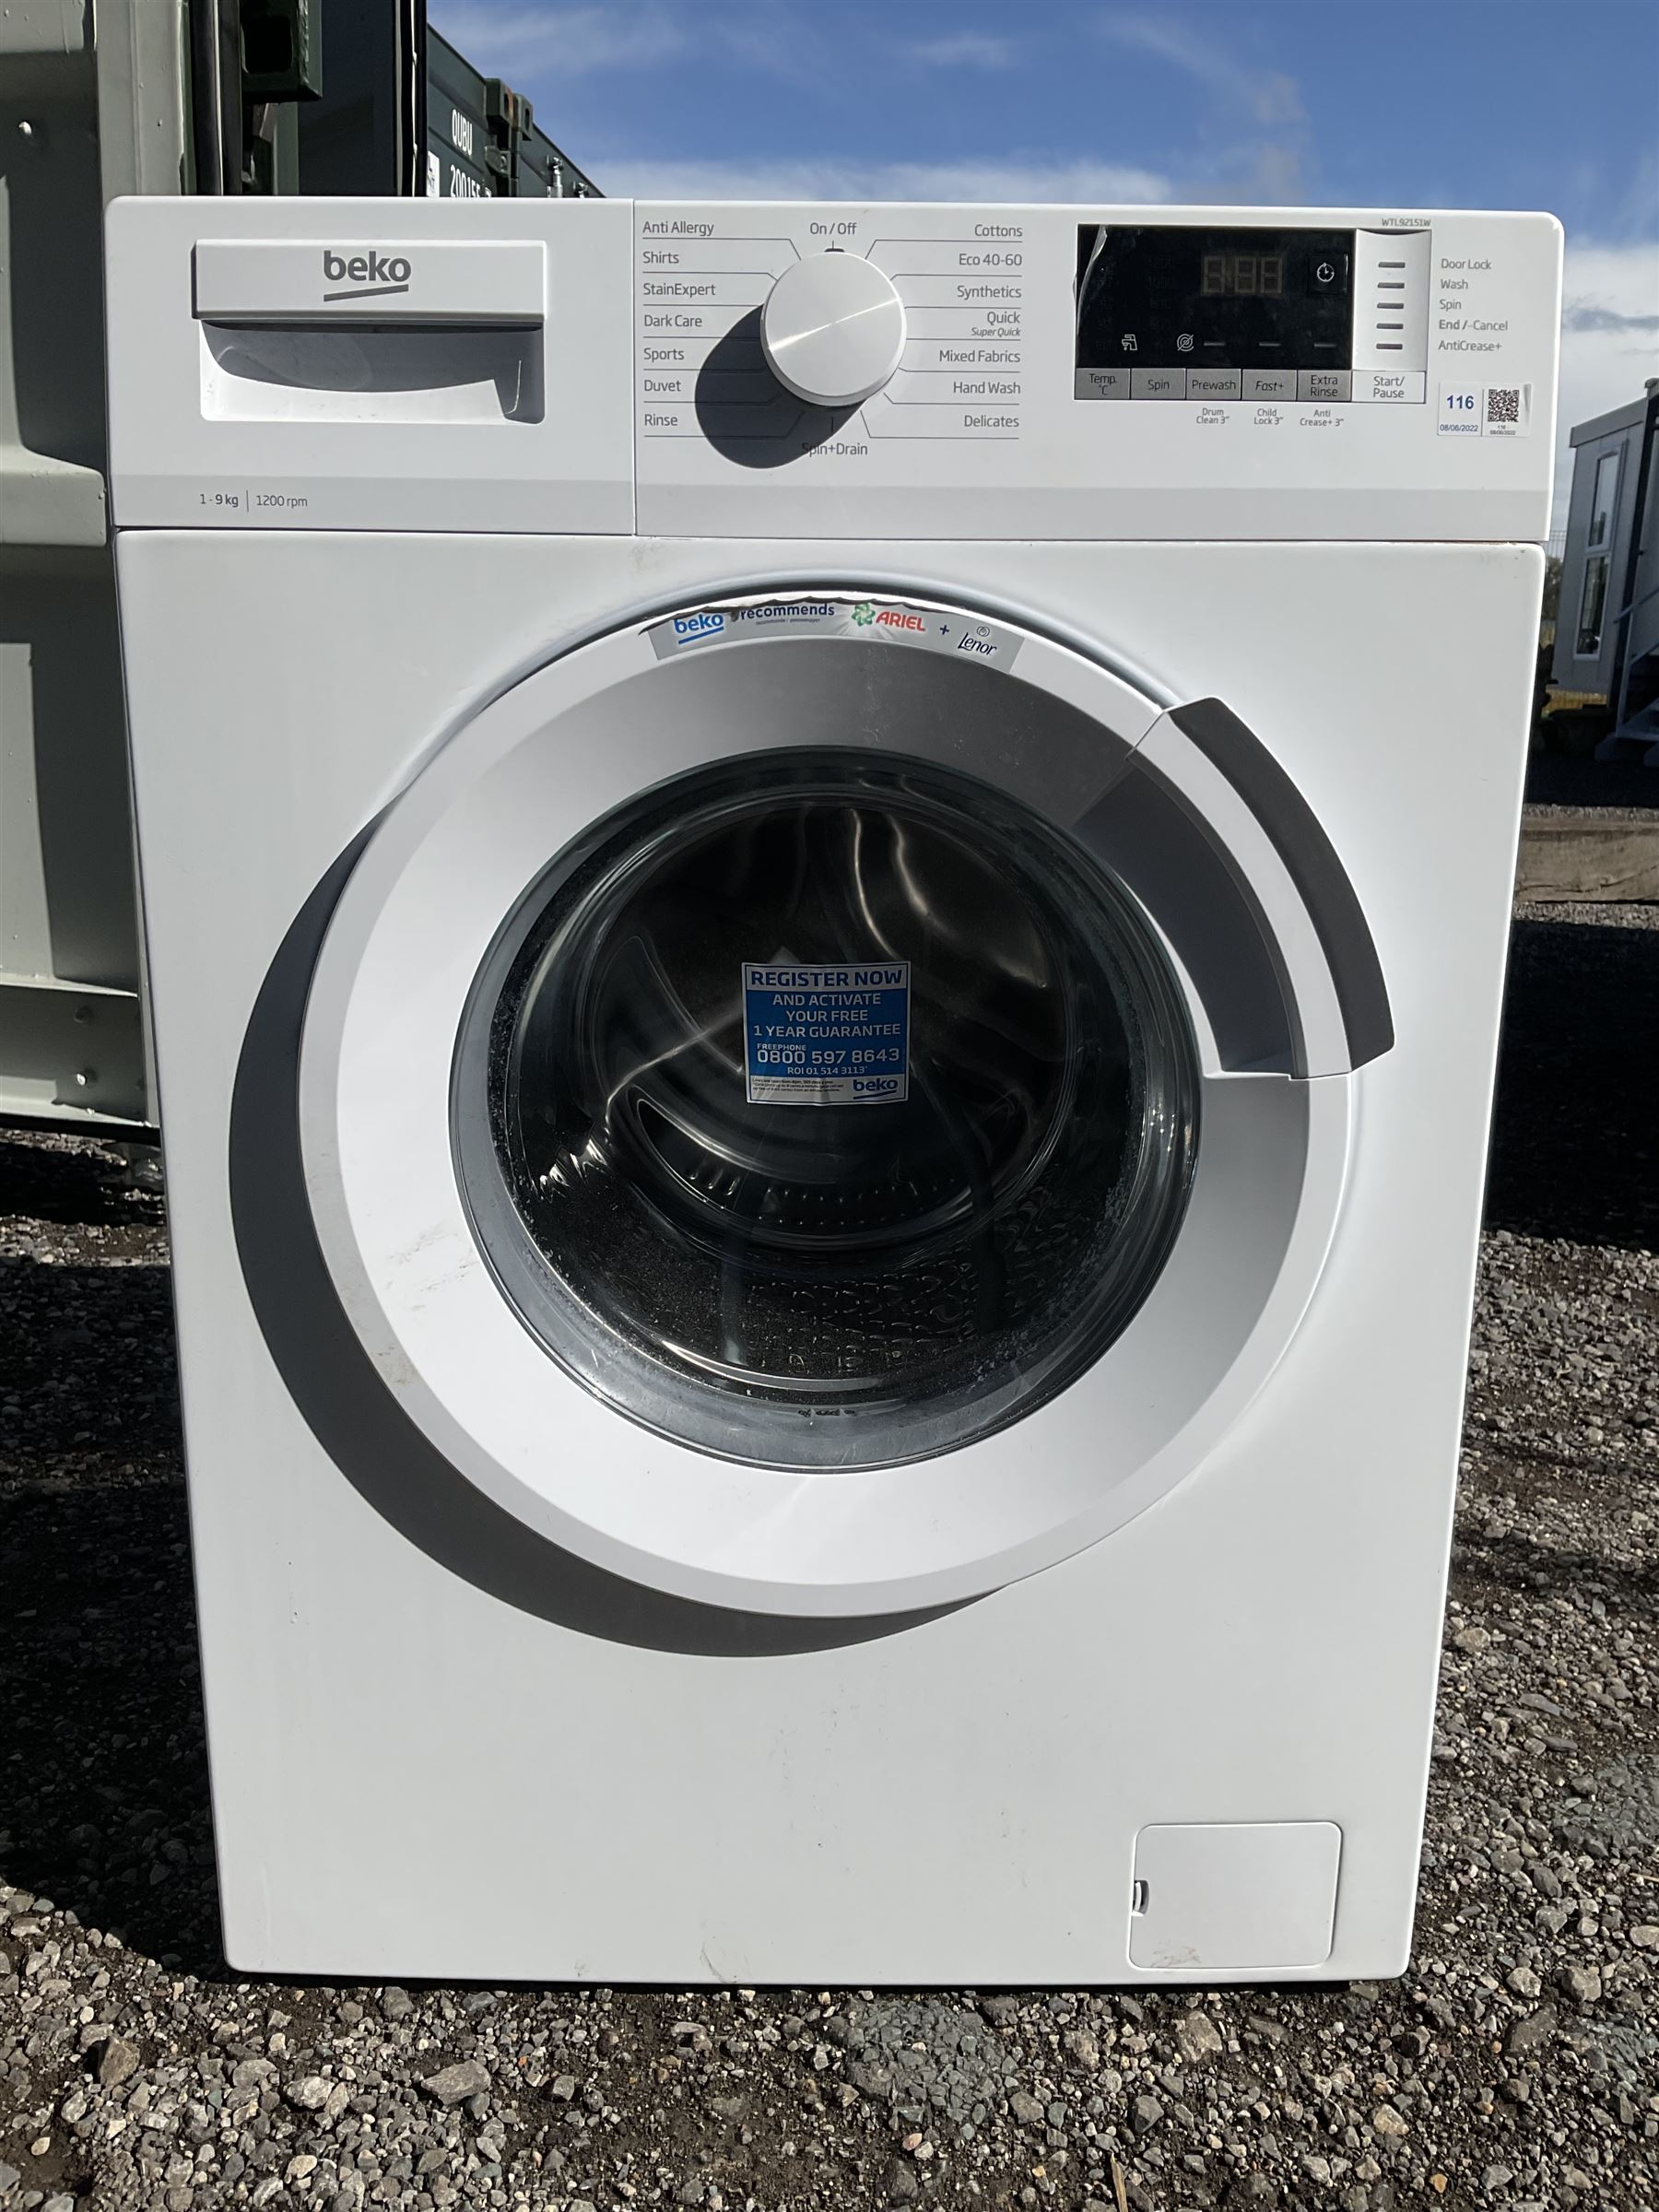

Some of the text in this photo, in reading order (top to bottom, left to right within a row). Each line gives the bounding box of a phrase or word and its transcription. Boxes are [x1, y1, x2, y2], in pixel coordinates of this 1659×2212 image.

[452, 109, 473, 155] QUBU
[642, 221, 714, 237] Anti Allergy
[810, 222, 827, 235] On
[837, 222, 857, 235] Off
[1382, 218, 1431, 227] WTL92151W
[974, 224, 1023, 237] Cottons
[642, 251, 679, 264] Shirts
[959, 253, 1022, 266] Eco 40-60
[1441, 258, 1491, 270] Door Lock
[324, 250, 411, 282] beko
[1441, 278, 1468, 289] Wash
[643, 283, 715, 298] StainExpert
[957, 286, 1022, 300] Synthetics
[1439, 299, 1462, 312] Spin
[644, 314, 702, 326] Dark Care
[986, 312, 1020, 325] Quick
[1439, 319, 1460, 330] End
[971, 326, 1021, 337] Super Quick
[1438, 340, 1502, 351] AntiCrease+
[643, 347, 685, 362] Sports
[939, 349, 1020, 362] Mixed Fabrics
[644, 379, 681, 392] Duvet
[1088, 373, 1116, 385] Temp.
[1147, 379, 1170, 392] Spin
[1192, 380, 1236, 390] Prewash
[1311, 374, 1338, 385] Extra
[1373, 376, 1405, 386] Start/
[953, 382, 1021, 394] Hand Wash
[1254, 381, 1284, 392] Fast+
[1310, 387, 1338, 397] Rinse
[1372, 388, 1405, 398] Pause
[1446, 394, 1475, 409] 116
[1202, 407, 1224, 416] Drum
[1257, 408, 1277, 417] Child
[1313, 409, 1331, 418] Anti
[644, 414, 678, 427] Rinse
[964, 415, 1020, 428] Delicates
[1196, 416, 1218, 424] Clean
[1253, 417, 1273, 425] Lock
[1300, 418, 1333, 427] Crease+
[1440, 424, 1479, 432] 08/06/2022
[802, 442, 868, 457] Spin+Drain
[200, 494, 206, 505] 1
[215, 494, 223, 505] 9
[225, 494, 239, 508] kg
[256, 495, 308, 509] 1200 rpm
[674, 614, 724, 634] beko
[741, 604, 835, 621] recommends
[876, 611, 925, 632] ARIEL
[958, 632, 997, 657] Lenor
[751, 970, 902, 987] REGISTER NOW
[772, 993, 881, 1006] AND ACTIVATE
[786, 1009, 868, 1022] YOUR FREE
[754, 1023, 900, 1038] 1 YEAR GUARANTEE
[757, 1048, 900, 1065] 0800 597 8643
[787, 1066, 805, 1075] ROI
[820, 1066, 839, 1075] 514
[853, 1078, 899, 1091] beko
